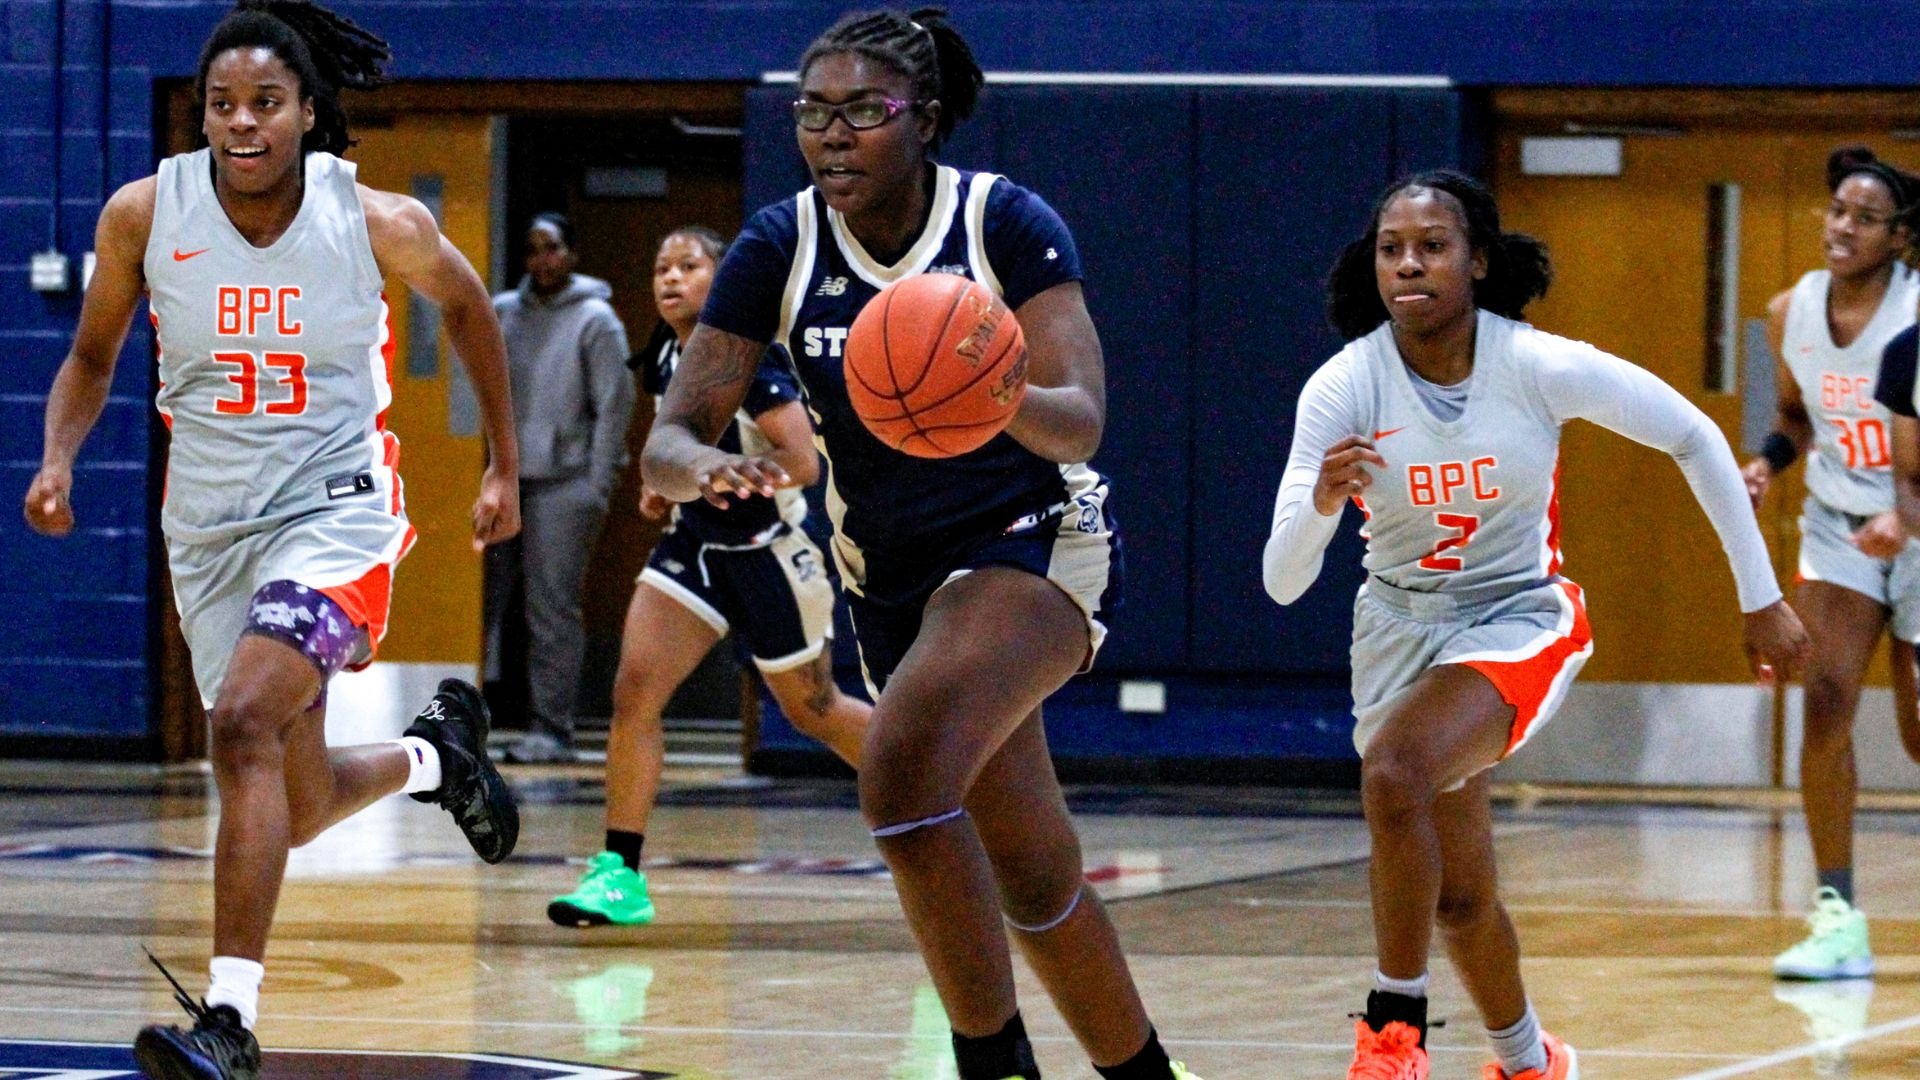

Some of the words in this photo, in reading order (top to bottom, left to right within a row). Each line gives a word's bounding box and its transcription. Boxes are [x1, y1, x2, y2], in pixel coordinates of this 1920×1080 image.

[216, 285, 303, 336] BPC
[803, 326, 848, 357] ST
[211, 350, 309, 416] 33
[1822, 373, 1874, 410] BPC
[1828, 418, 1893, 470] 30
[1405, 455, 1500, 506] BPC
[1417, 512, 1480, 572] 2
